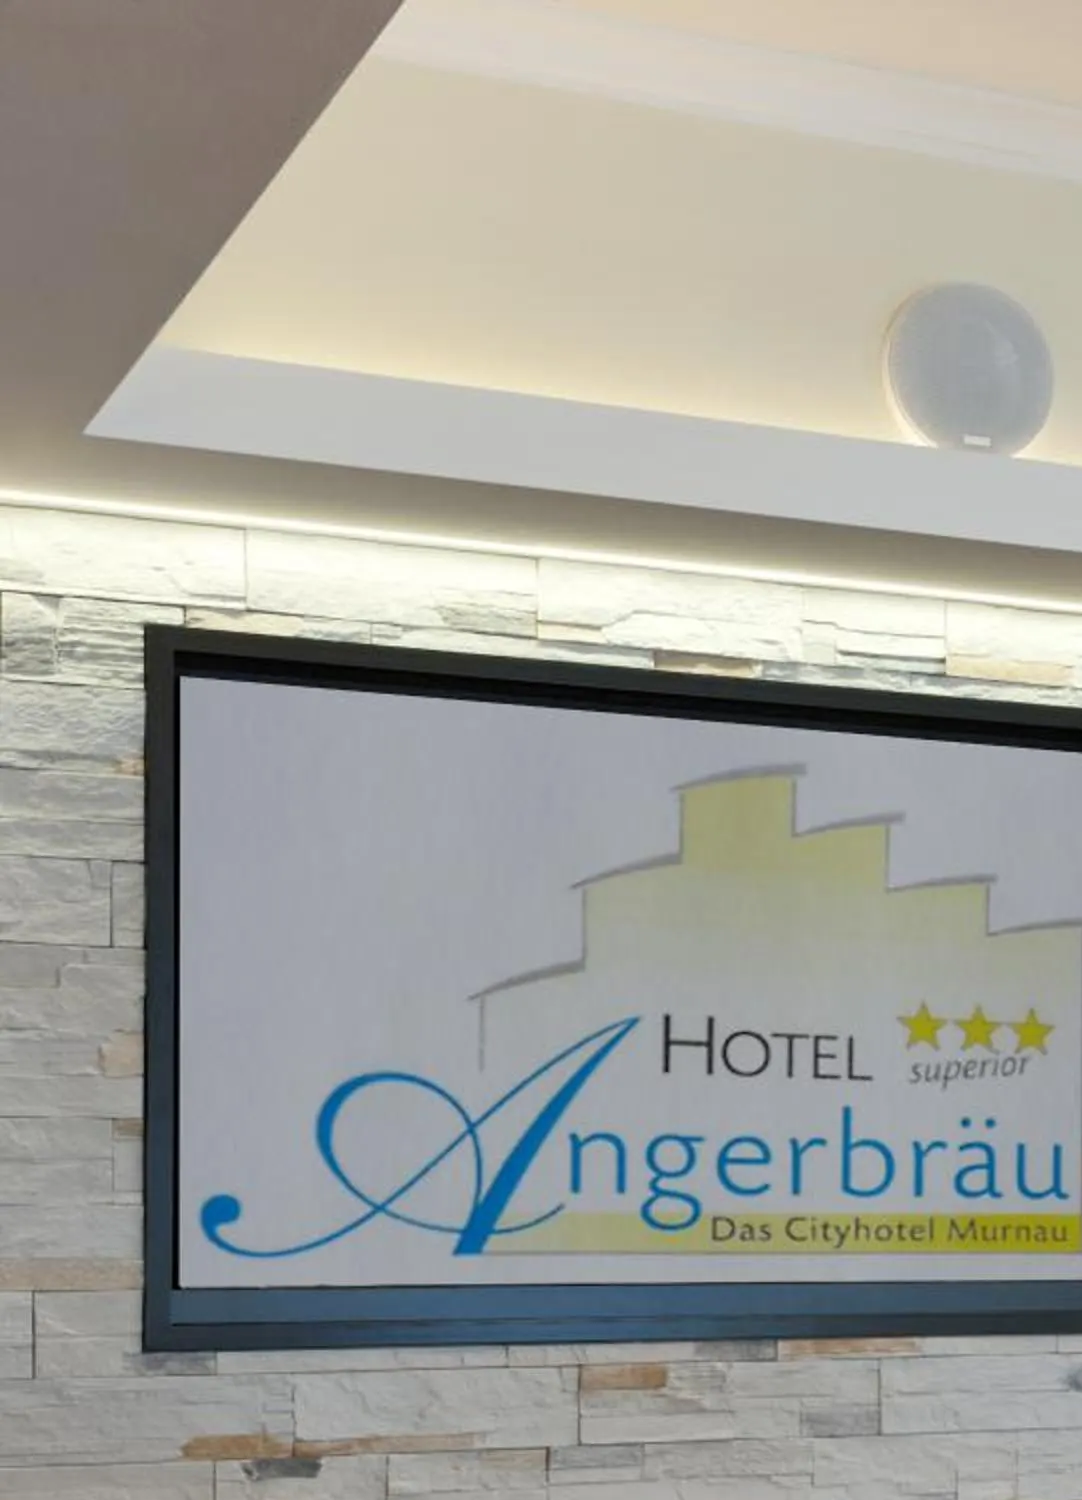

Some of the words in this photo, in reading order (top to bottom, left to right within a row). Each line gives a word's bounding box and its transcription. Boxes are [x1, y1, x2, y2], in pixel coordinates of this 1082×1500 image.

[662, 1013, 874, 1082] HOTEL
[909, 1054, 1031, 1091] superior
[200, 1015, 1070, 1258] Angerbräu
[710, 1216, 772, 1243] Das
[784, 1215, 936, 1249] Cityhotel
[947, 1217, 1070, 1244] Murnau
